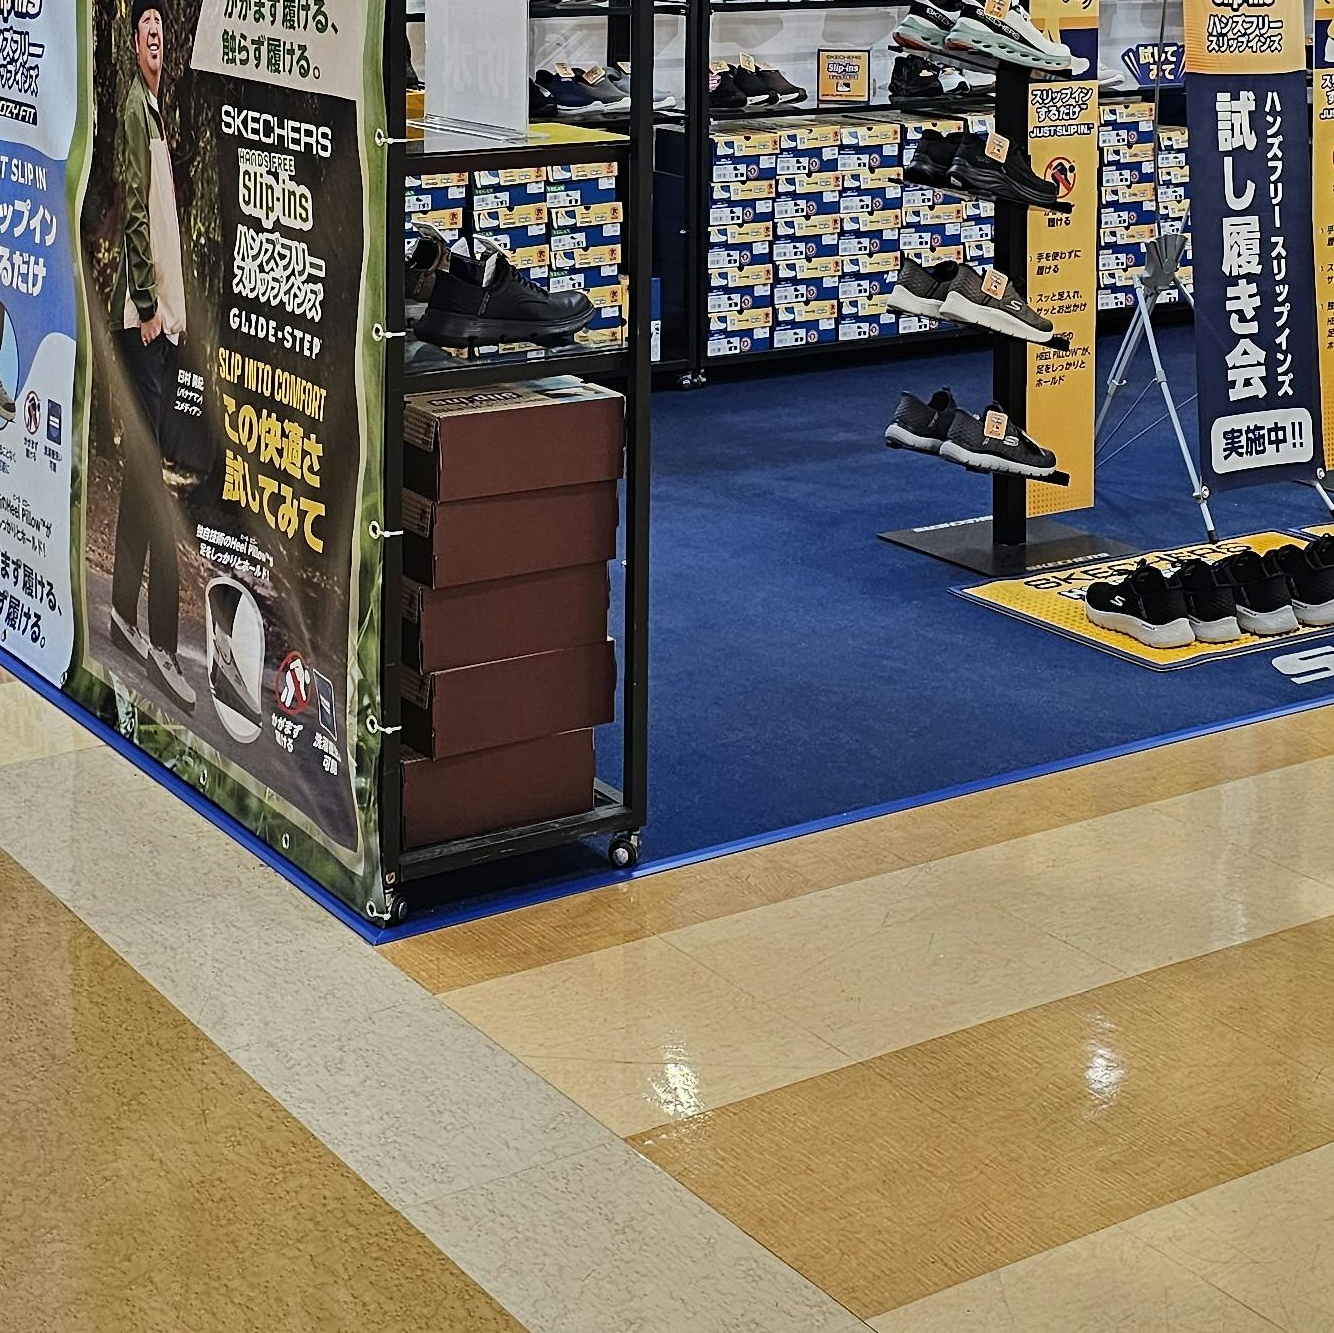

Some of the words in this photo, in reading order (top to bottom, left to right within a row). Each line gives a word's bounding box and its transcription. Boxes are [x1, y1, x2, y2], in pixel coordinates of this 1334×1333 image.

[1207, 14, 1283, 37] ハンズフリー
[1207, 35, 1282, 53] スリップインズ
[222, 29, 320, 80] 触らず履ける。
[19, 107, 35, 124] FIT
[1031, 87, 1093, 105] スリップイン
[222, 105, 332, 158] SKECHERS
[11, 158, 33, 185] SLIP
[35, 166, 47, 191] IN
[238, 148, 269, 170] HANDS
[271, 153, 295, 175] FREE
[240, 166, 312, 229] Slip-ins
[234, 224, 326, 282] ハンズフリー
[1216, 91, 1267, 401] 試し履き会
[230, 307, 322, 359] GLIDE-STEP
[219, 347, 242, 384] SLIP
[244, 357, 272, 397] INTO
[274, 368, 327, 422] COMFORT
[223, 394, 324, 488] この快適さ
[1222, 421, 1304, 460] 実施中!!
[223, 449, 326, 554] 試してみて
